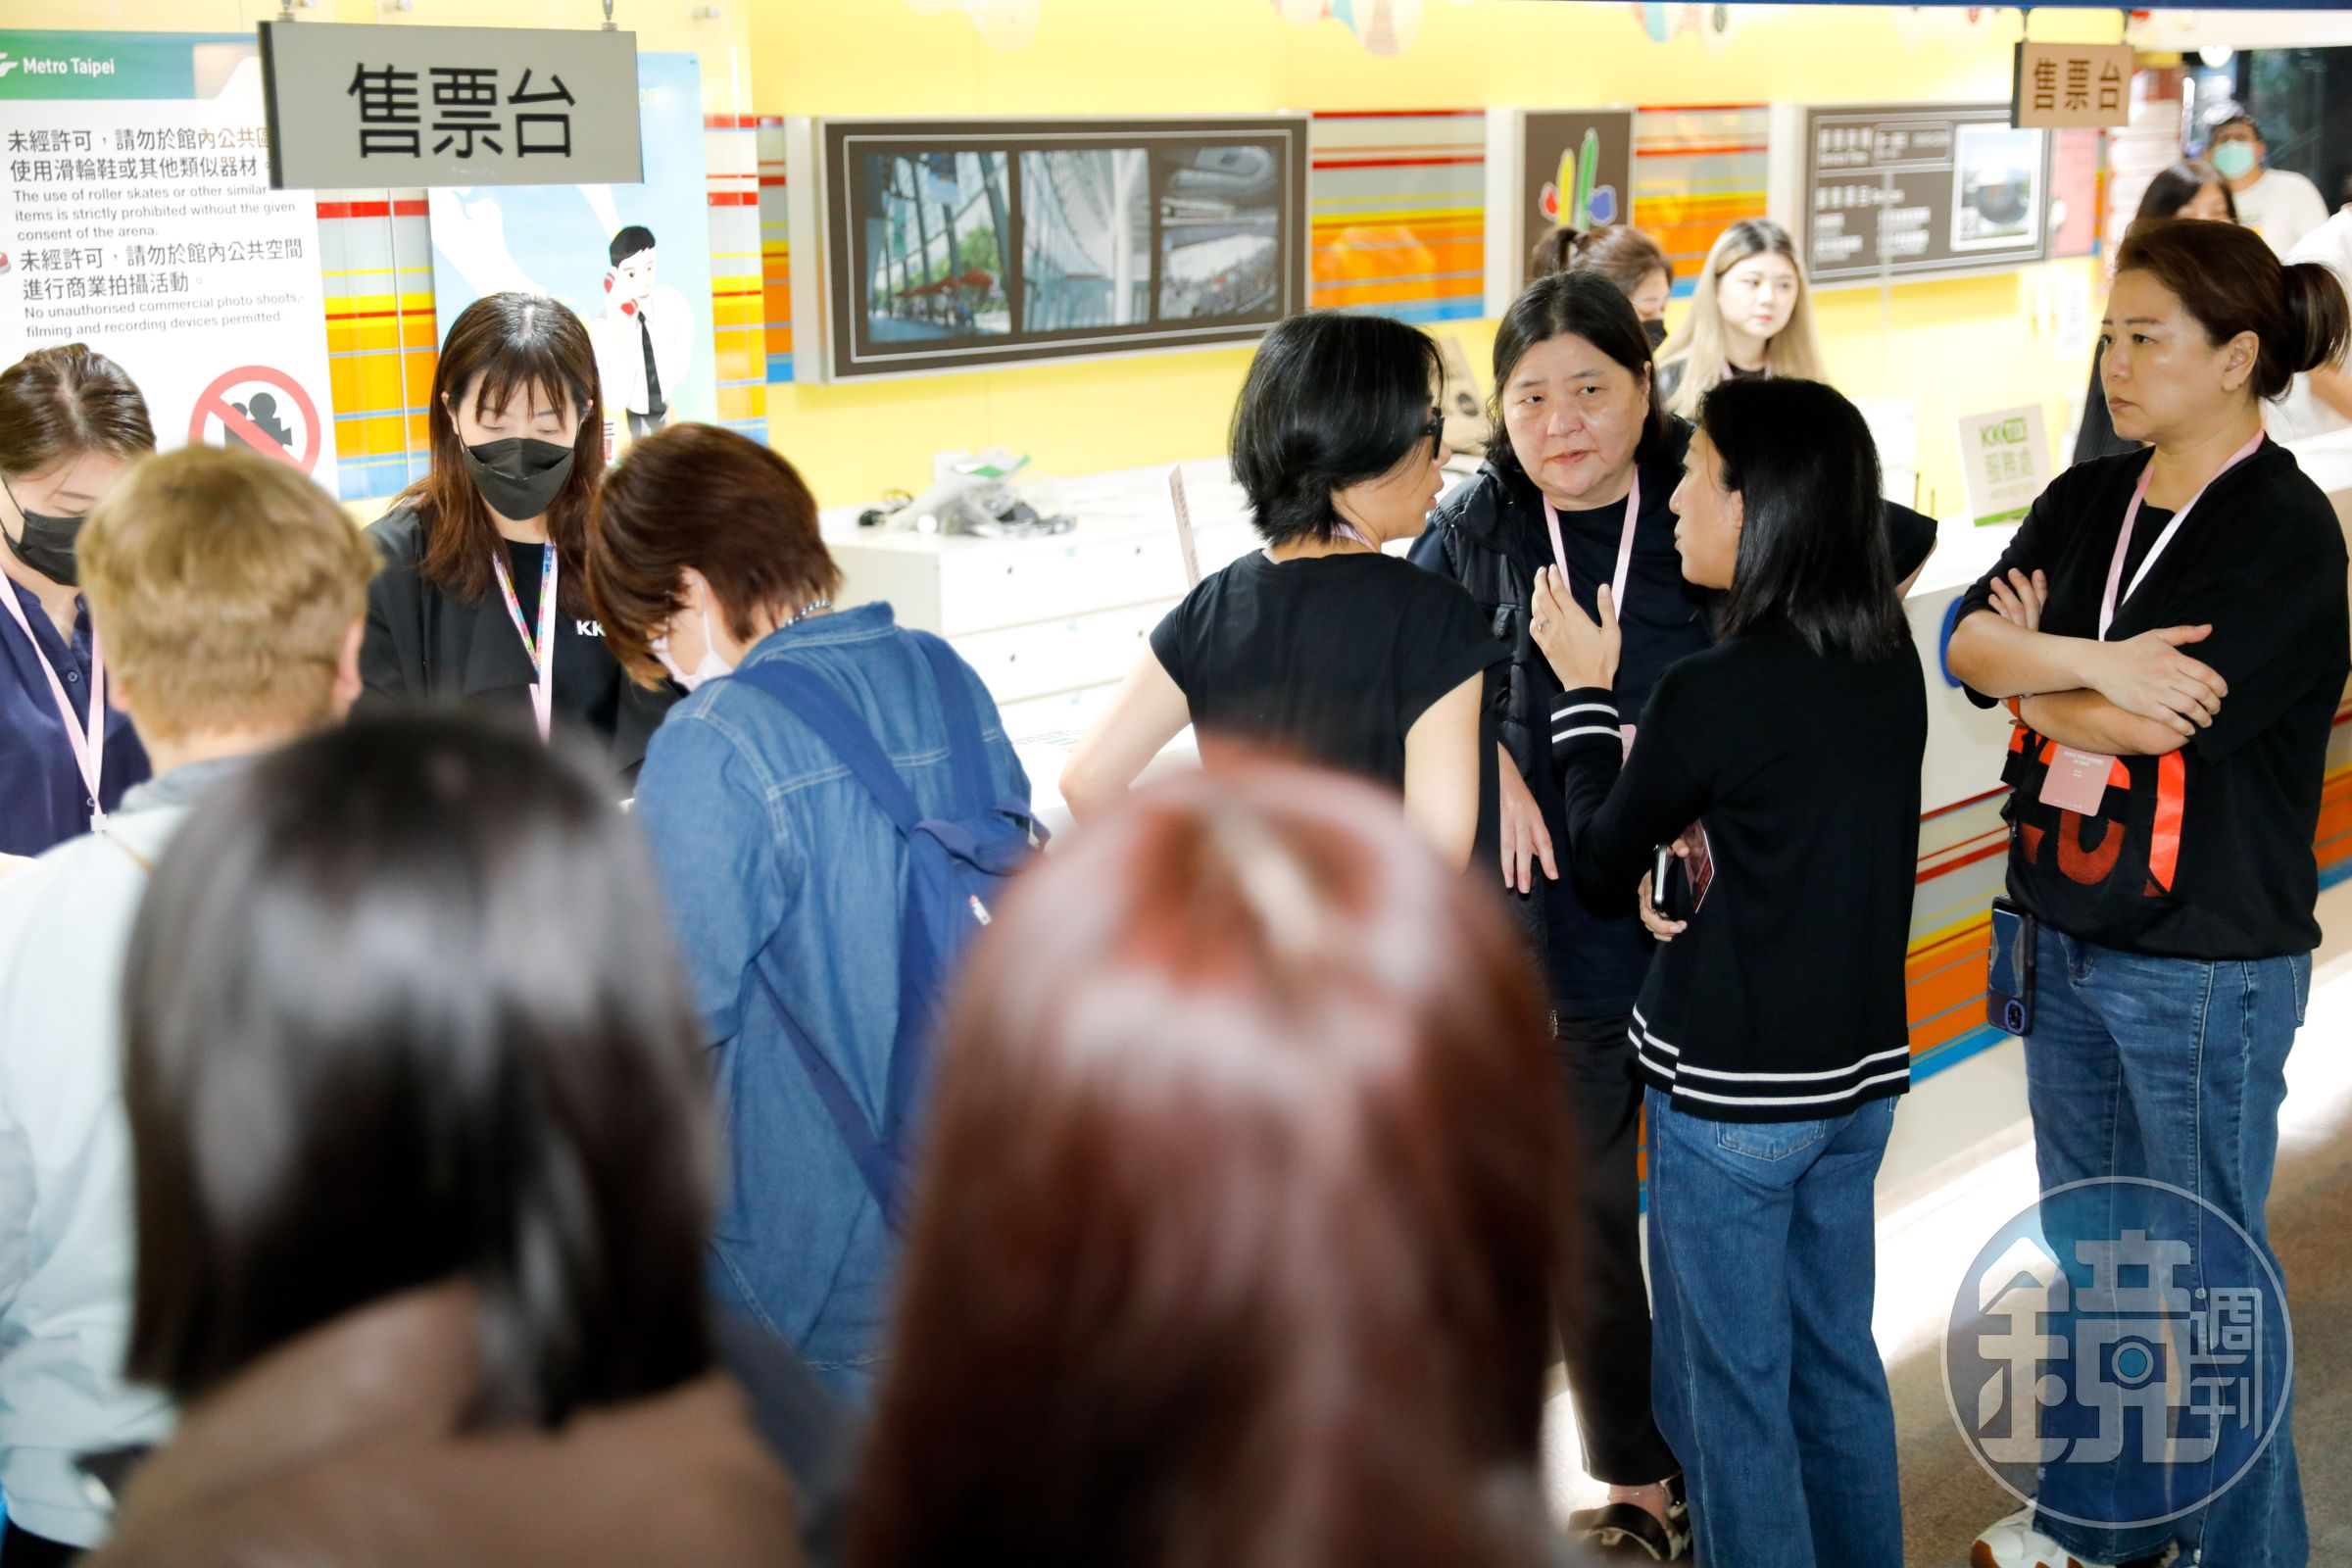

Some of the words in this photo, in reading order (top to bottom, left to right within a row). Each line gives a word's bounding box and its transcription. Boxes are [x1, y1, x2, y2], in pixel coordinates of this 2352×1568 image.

[23, 56, 69, 75] Metro
[70, 56, 116, 78] Taipei
[2034, 57, 2122, 112] 售票台
[347, 62, 576, 159] 售票台
[13, 189, 40, 203] The
[43, 191, 68, 202] use
[72, 189, 85, 202] of
[88, 187, 123, 201] roller
[126, 186, 171, 200] skates
[172, 188, 187, 199] or
[189, 185, 223, 198] other
[226, 184, 267, 196] similar
[15, 209, 54, 222] items
[57, 208, 69, 221] is
[72, 206, 118, 221] strictly
[122, 203, 187, 220] prohibited
[190, 202, 238, 216] without
[240, 201, 261, 215] the
[263, 201, 296, 215] given
[17, 227, 73, 242] consent
[75, 226, 89, 239] of
[93, 225, 115, 239] the
[118, 224, 159, 238] arena.
[24, 306, 45, 319] No
[48, 300, 136, 318] unauthorised
[139, 296, 214, 314] commercial
[217, 294, 254, 310] photo
[26, 323, 73, 339] filming
[76, 322, 102, 336] and
[104, 318, 168, 334] recording
[170, 314, 219, 329] devices
